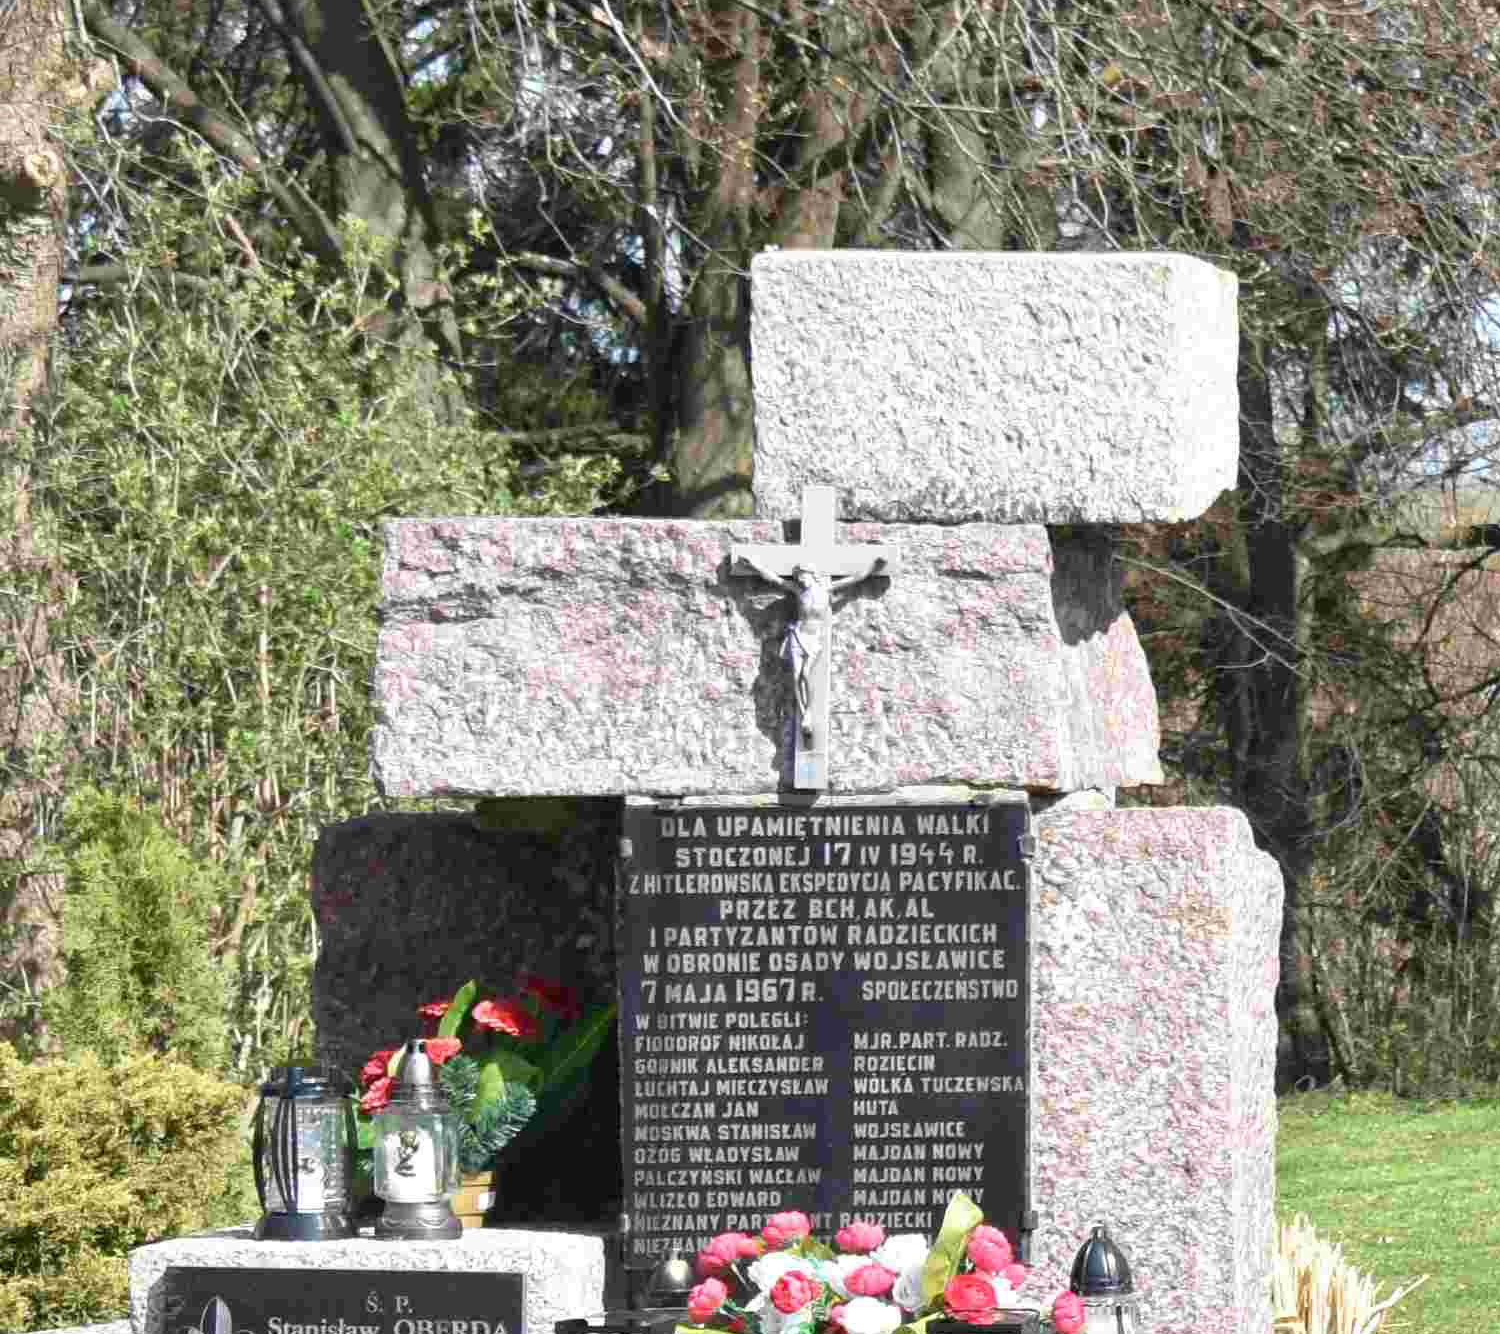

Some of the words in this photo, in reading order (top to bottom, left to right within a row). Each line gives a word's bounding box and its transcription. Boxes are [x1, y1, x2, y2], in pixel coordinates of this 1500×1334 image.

[661, 816, 708, 837] DLA
[717, 815, 905, 841] UPAMIĘTNIENIA
[917, 814, 989, 834] WALKI
[675, 846, 811, 867] STOCZONEJ
[824, 842, 851, 866] 17
[861, 845, 880, 865] IV
[891, 842, 954, 866] 1944
[963, 844, 984, 864] R.
[719, 898, 796, 920] PRZEZ
[649, 926, 656, 948] I
[664, 920, 838, 947] PARTYZANTÓW
[848, 923, 997, 945] RADZIECKICH
[643, 953, 660, 974] W
[667, 952, 761, 973] OBRONIE
[769, 951, 845, 972] OSADY
[853, 949, 1005, 971] WOJSŁAWICE
[641, 980, 657, 1004] 7
[665, 984, 728, 1004] MAJA
[735, 978, 795, 1003] 1967
[801, 981, 825, 1003] R.
[634, 1013, 650, 1030] W
[657, 1013, 719, 1030] BITWIE
[728, 1034, 805, 1052] NIKOŁAJ
[706, 1056, 825, 1074] ALEKSANDER
[716, 1078, 829, 1096] MIECZYSŁAW
[723, 1100, 760, 1118] JAN
[853, 1099, 899, 1116] HUTA
[633, 1124, 711, 1142] MOSKWA
[718, 1123, 816, 1141] STANISŁAW
[853, 1121, 966, 1139] WOJSŁAWICE
[688, 1145, 800, 1163] WŁADYSŁAW
[852, 1144, 926, 1161] MAJDAN
[932, 1143, 985, 1160] NOWY
[749, 1168, 822, 1185] WACŁAW
[852, 1166, 926, 1184] MAJDAN
[931, 1166, 984, 1183] NOWY
[706, 1191, 782, 1209] EDWARD
[852, 1189, 926, 1206] MAJDAN
[632, 1212, 720, 1231] NIEZNANY
